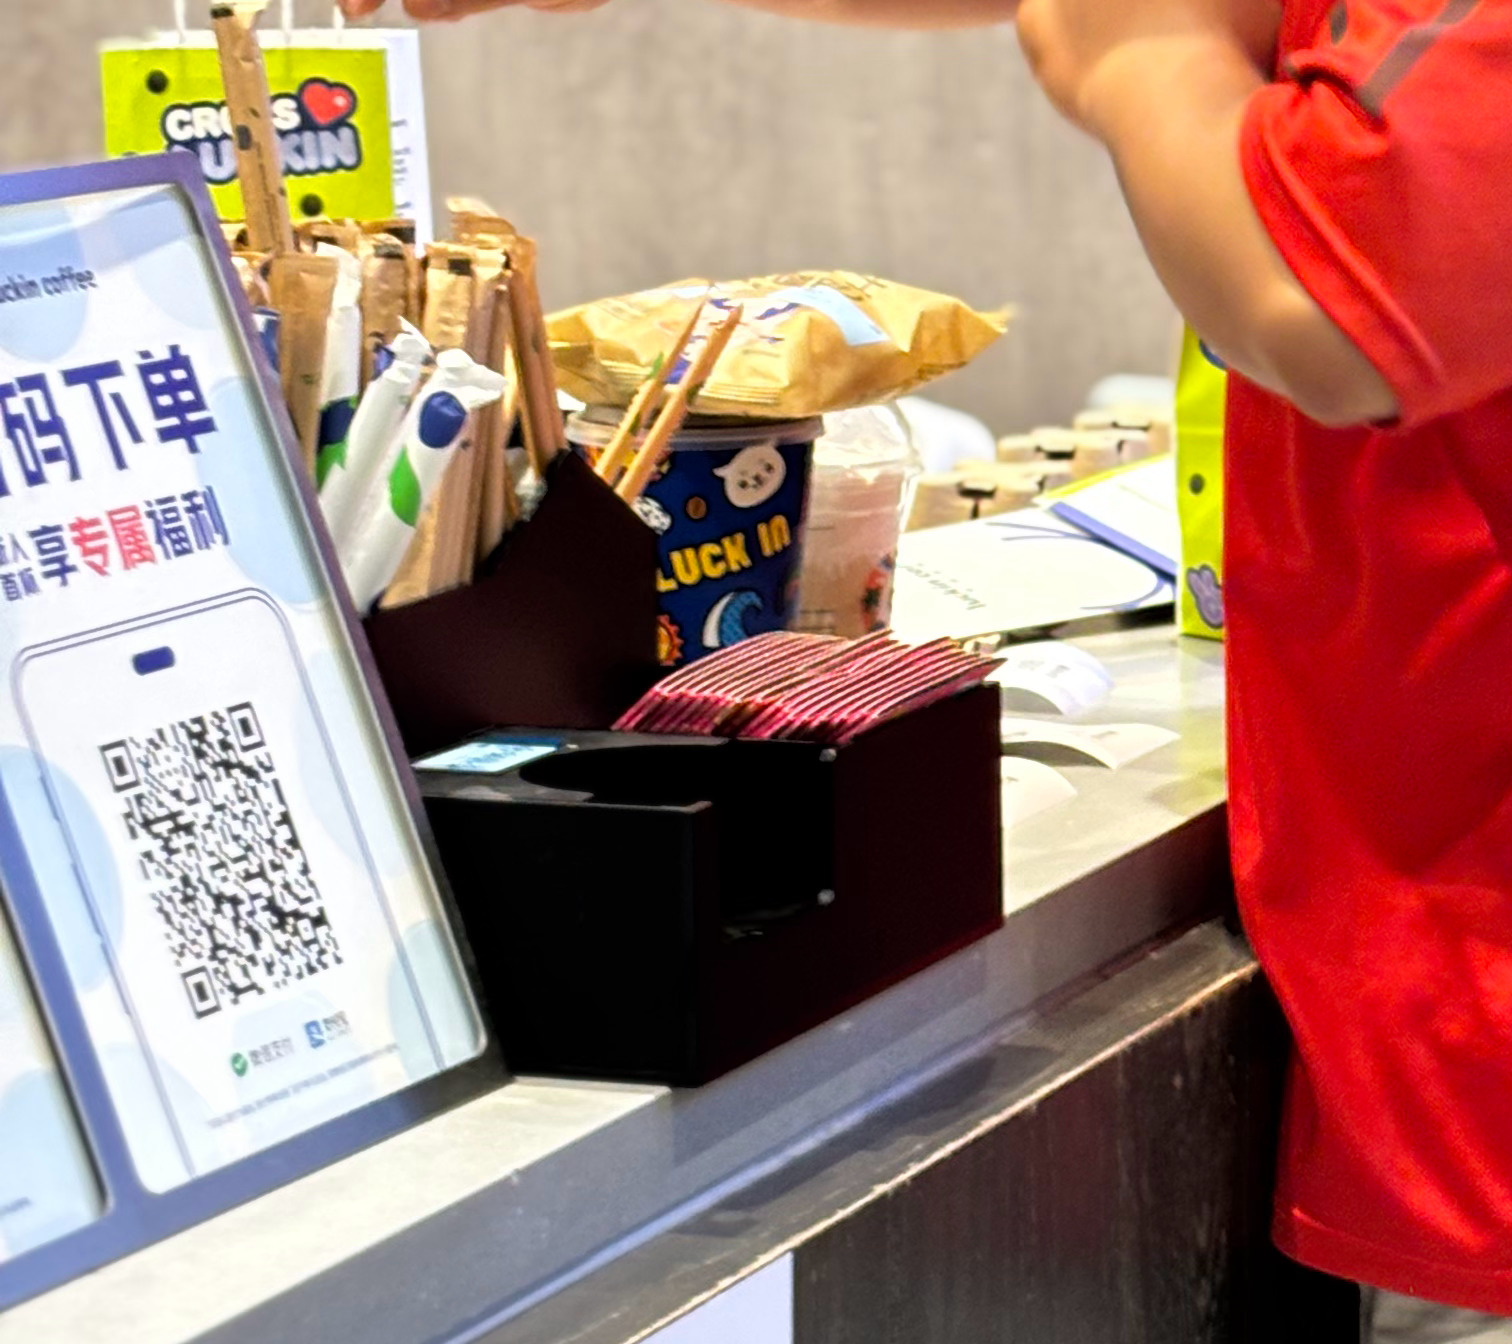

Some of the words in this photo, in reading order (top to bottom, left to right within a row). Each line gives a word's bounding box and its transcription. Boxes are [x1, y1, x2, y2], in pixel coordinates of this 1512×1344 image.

[164, 96, 303, 143] CRS
[41, 265, 98, 296] coffee
[0, 343, 218, 498] 码下单
[27, 485, 230, 587] 享专属福利
[655, 531, 752, 594] LUCK
